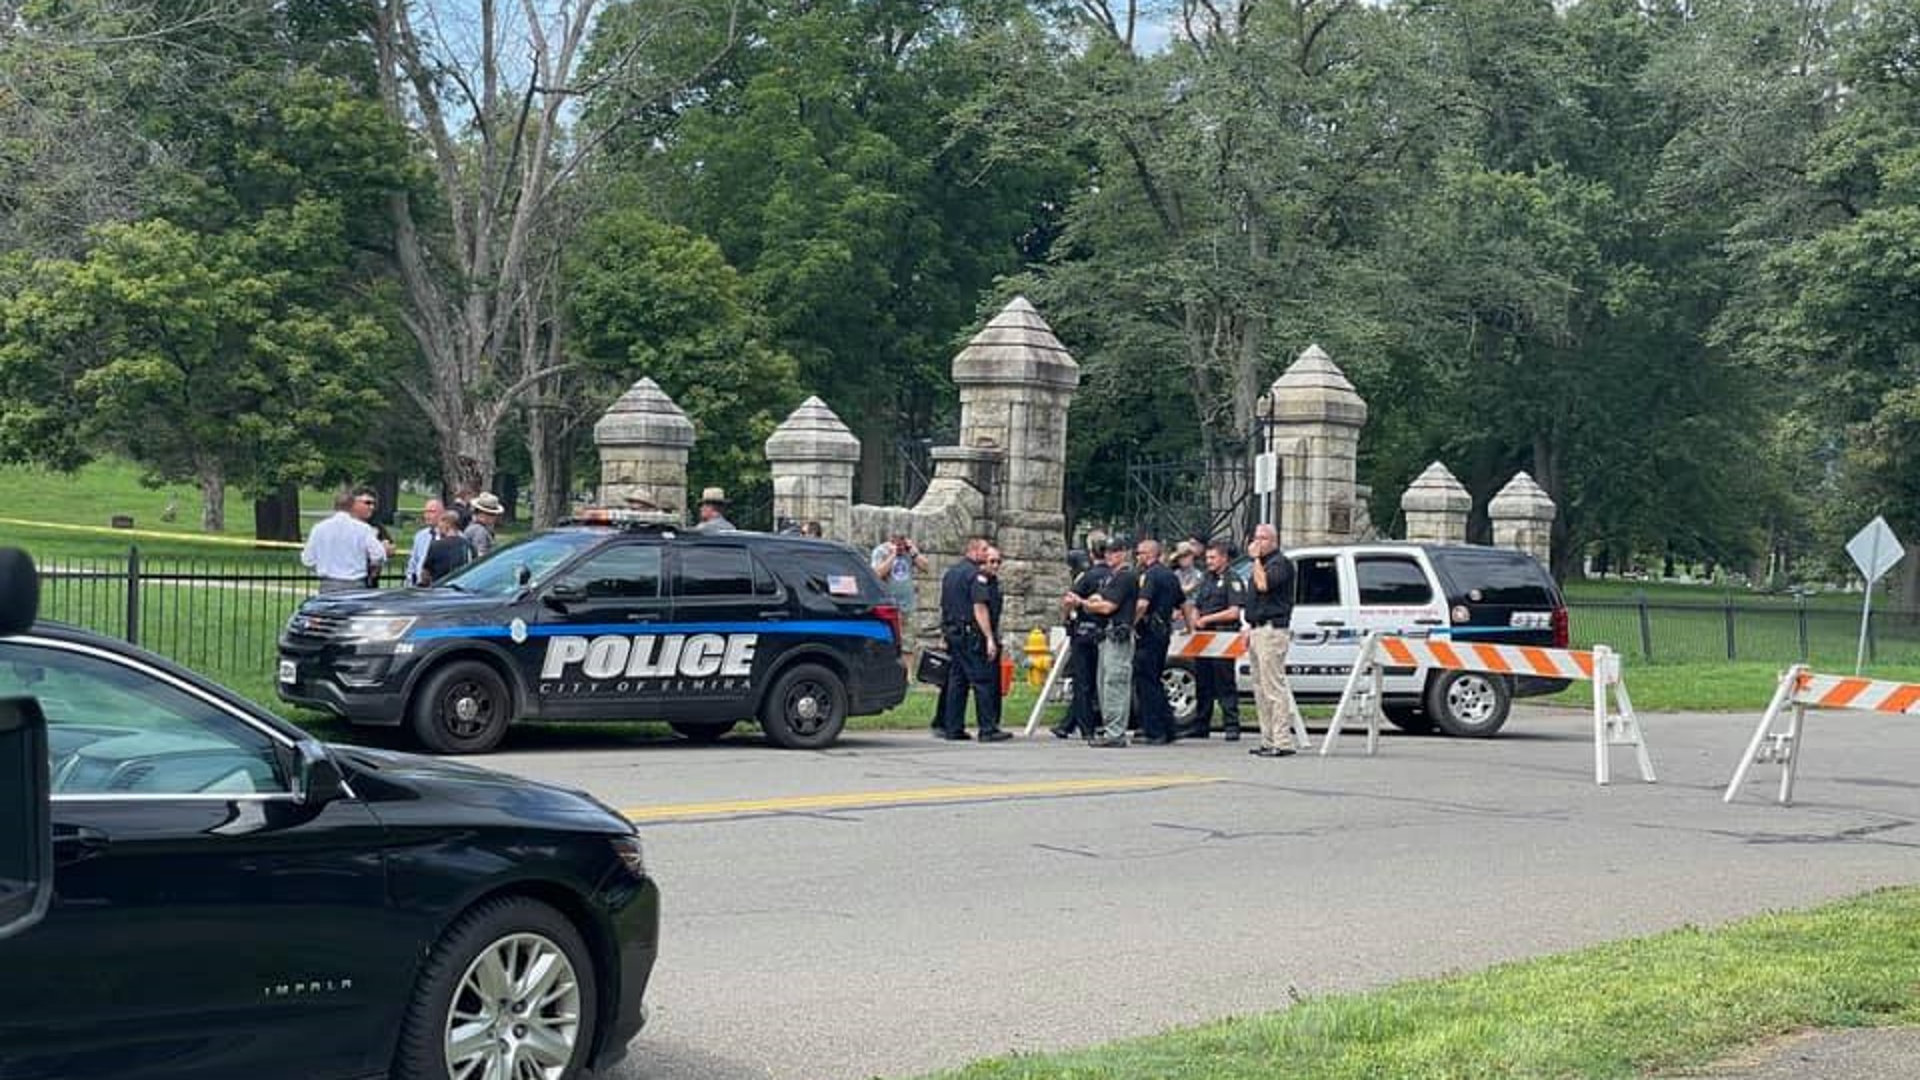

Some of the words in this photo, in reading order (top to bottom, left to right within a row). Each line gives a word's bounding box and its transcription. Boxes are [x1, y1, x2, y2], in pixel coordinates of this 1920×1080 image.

[540, 633, 758, 679] POLICE
[539, 682, 601, 694] CITY
[616, 681, 649, 692] OF
[661, 680, 752, 692] ELMIRA
[264, 979, 352, 997] IMPALA
